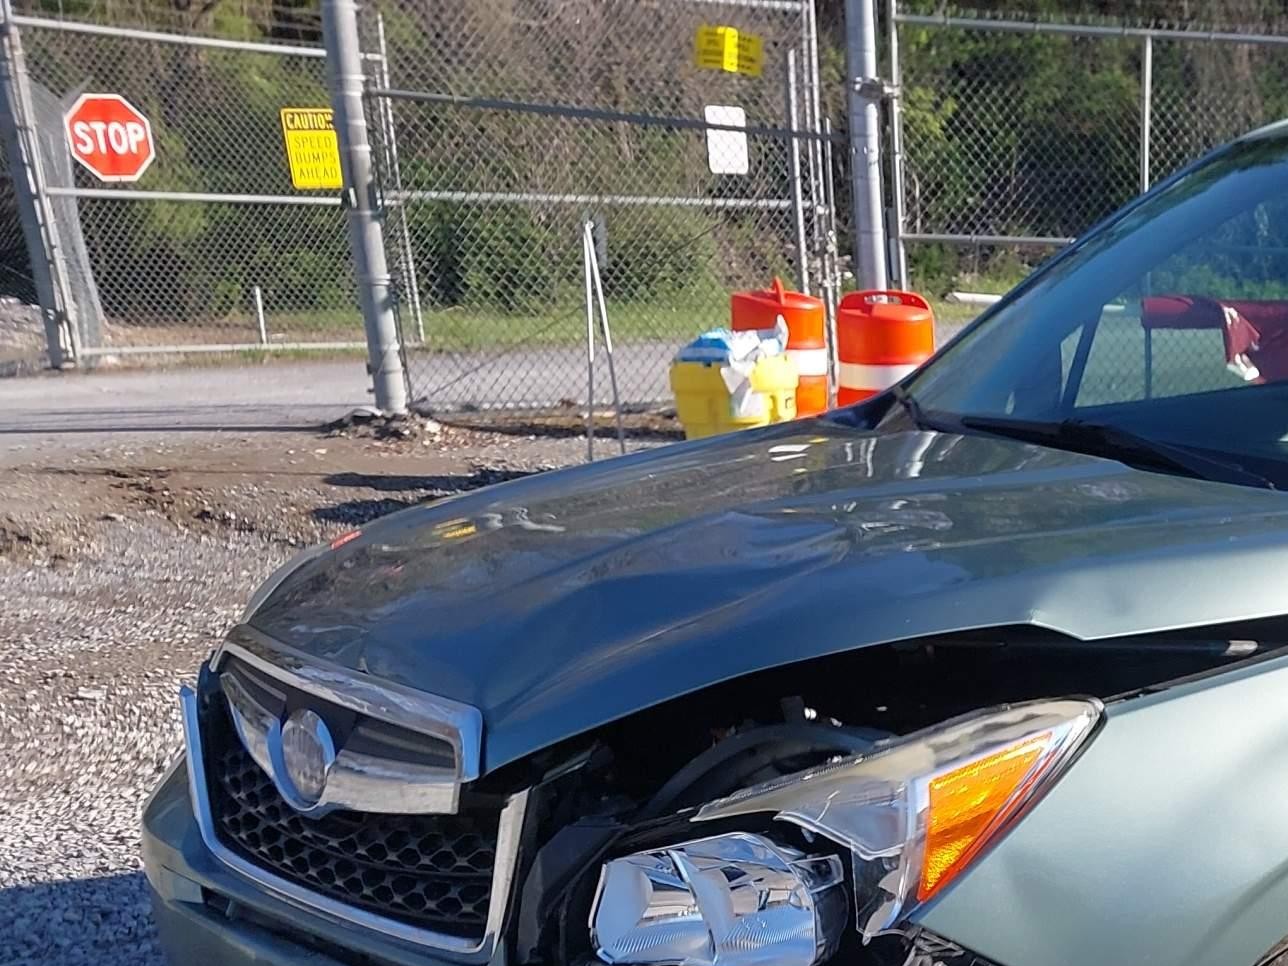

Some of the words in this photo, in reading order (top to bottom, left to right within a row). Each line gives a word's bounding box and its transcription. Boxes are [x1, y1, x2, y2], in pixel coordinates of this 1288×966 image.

[286, 112, 334, 130] CAUTION
[73, 120, 146, 155] STOP
[294, 135, 332, 149] SPEED
[299, 166, 338, 179] AHEAD
